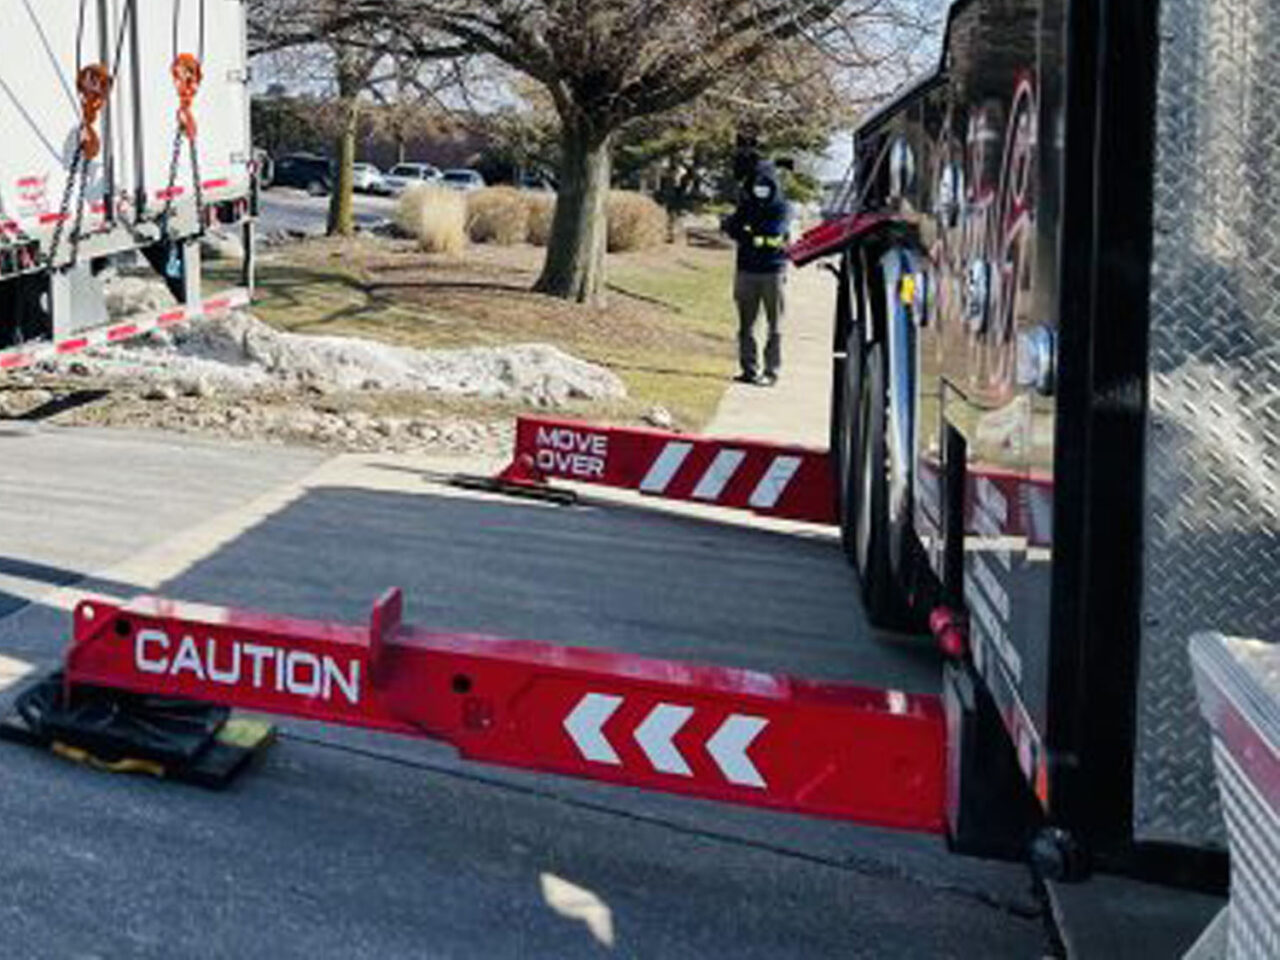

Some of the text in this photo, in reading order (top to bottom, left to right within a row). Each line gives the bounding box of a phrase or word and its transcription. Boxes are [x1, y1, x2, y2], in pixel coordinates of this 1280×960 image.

[535, 426, 608, 456] MOVE
[537, 448, 605, 477] OVER
[134, 628, 361, 705] CAUTION
